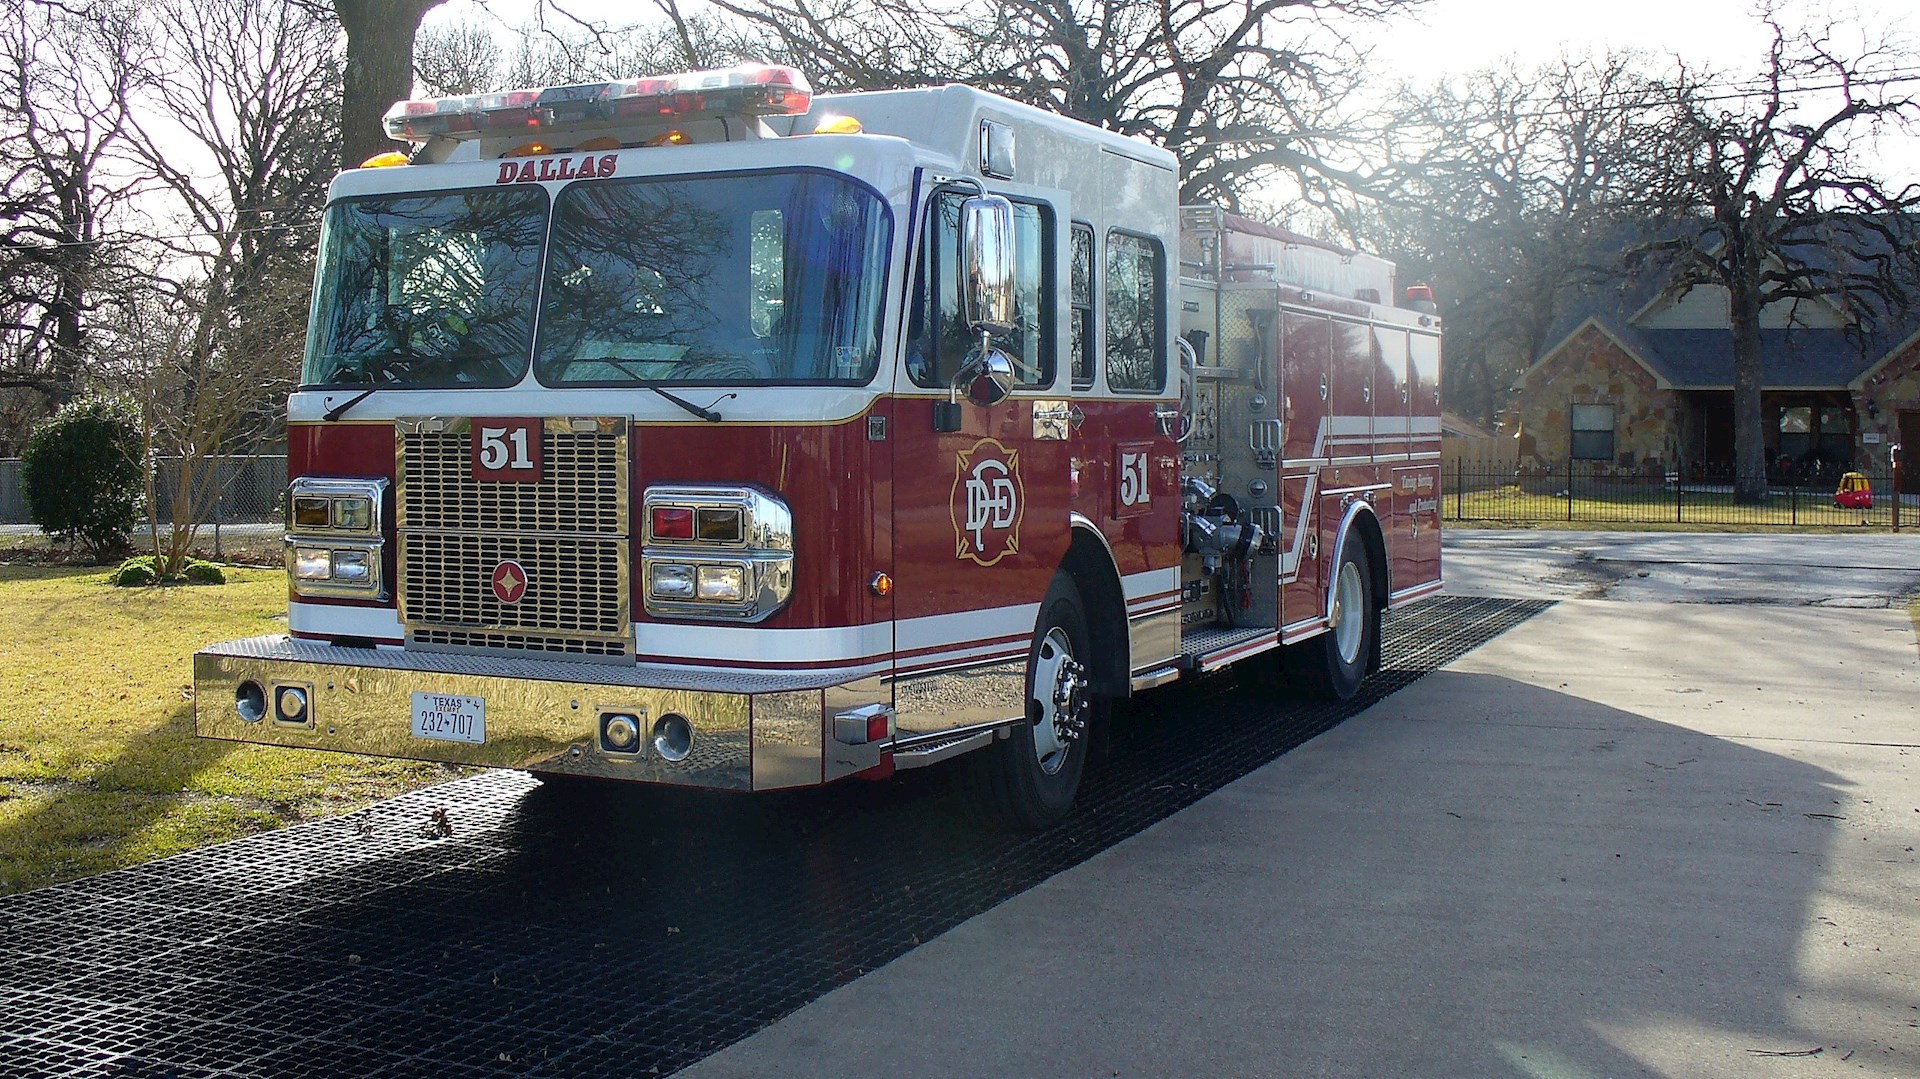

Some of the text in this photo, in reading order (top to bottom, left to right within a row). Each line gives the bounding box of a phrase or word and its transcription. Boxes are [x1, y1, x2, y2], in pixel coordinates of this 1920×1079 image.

[496, 154, 619, 184] DALLAS
[479, 426, 534, 470] 51
[1120, 452, 1150, 506] 51
[433, 696, 462, 708] TEXAS
[435, 705, 460, 714] EXEMPT
